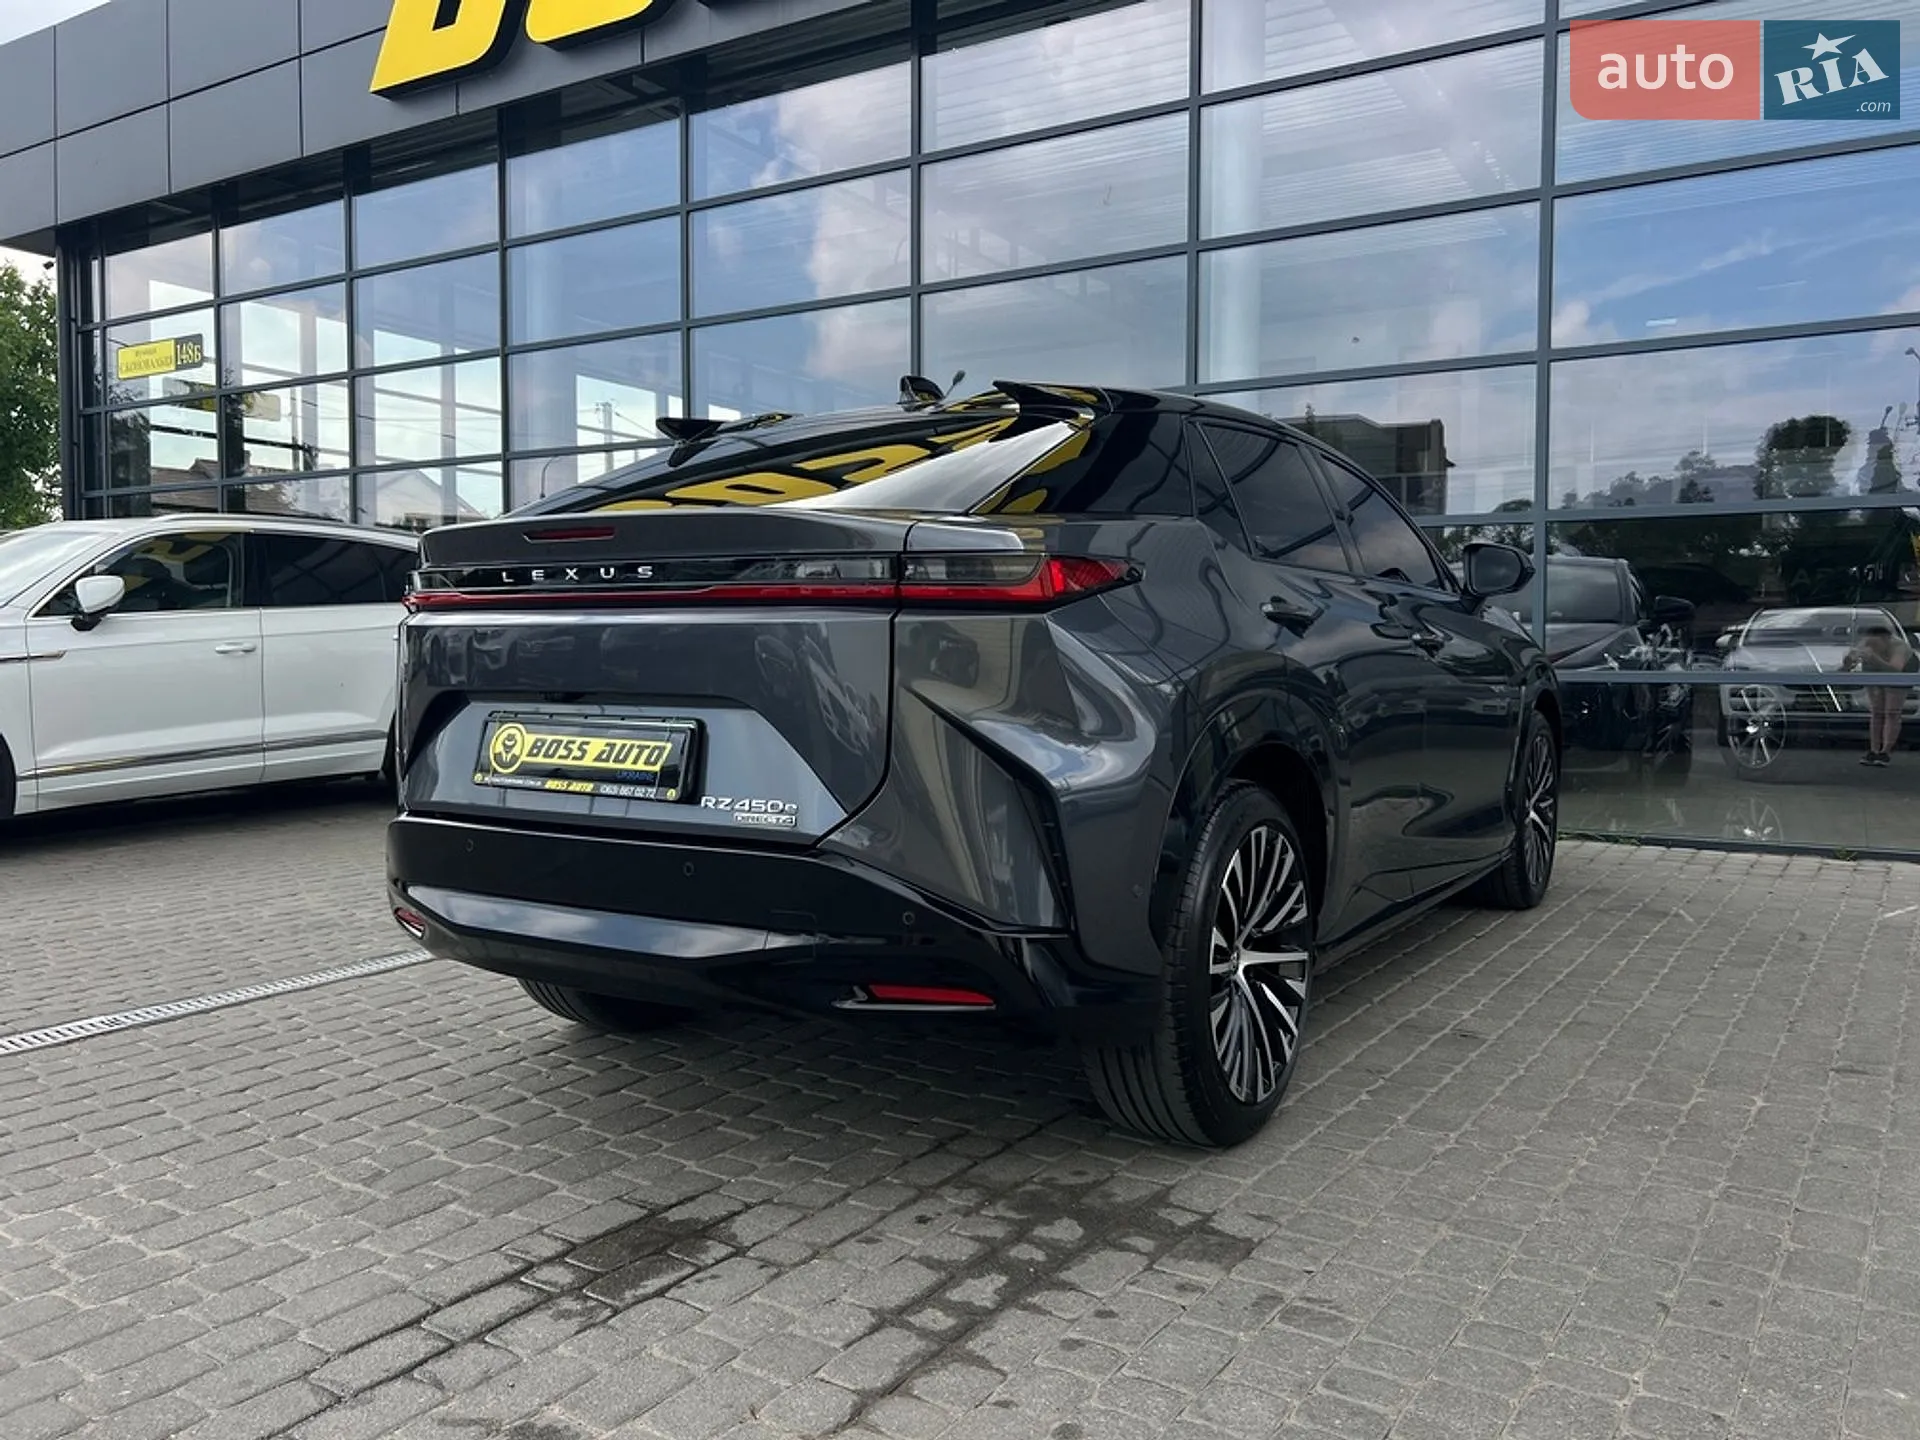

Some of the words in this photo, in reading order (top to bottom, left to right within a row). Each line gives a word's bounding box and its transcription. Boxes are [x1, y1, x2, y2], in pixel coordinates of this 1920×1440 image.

[501, 566, 654, 583] LEXUS
[526, 736, 591, 761] BOSS
[593, 741, 667, 767] AUTO
